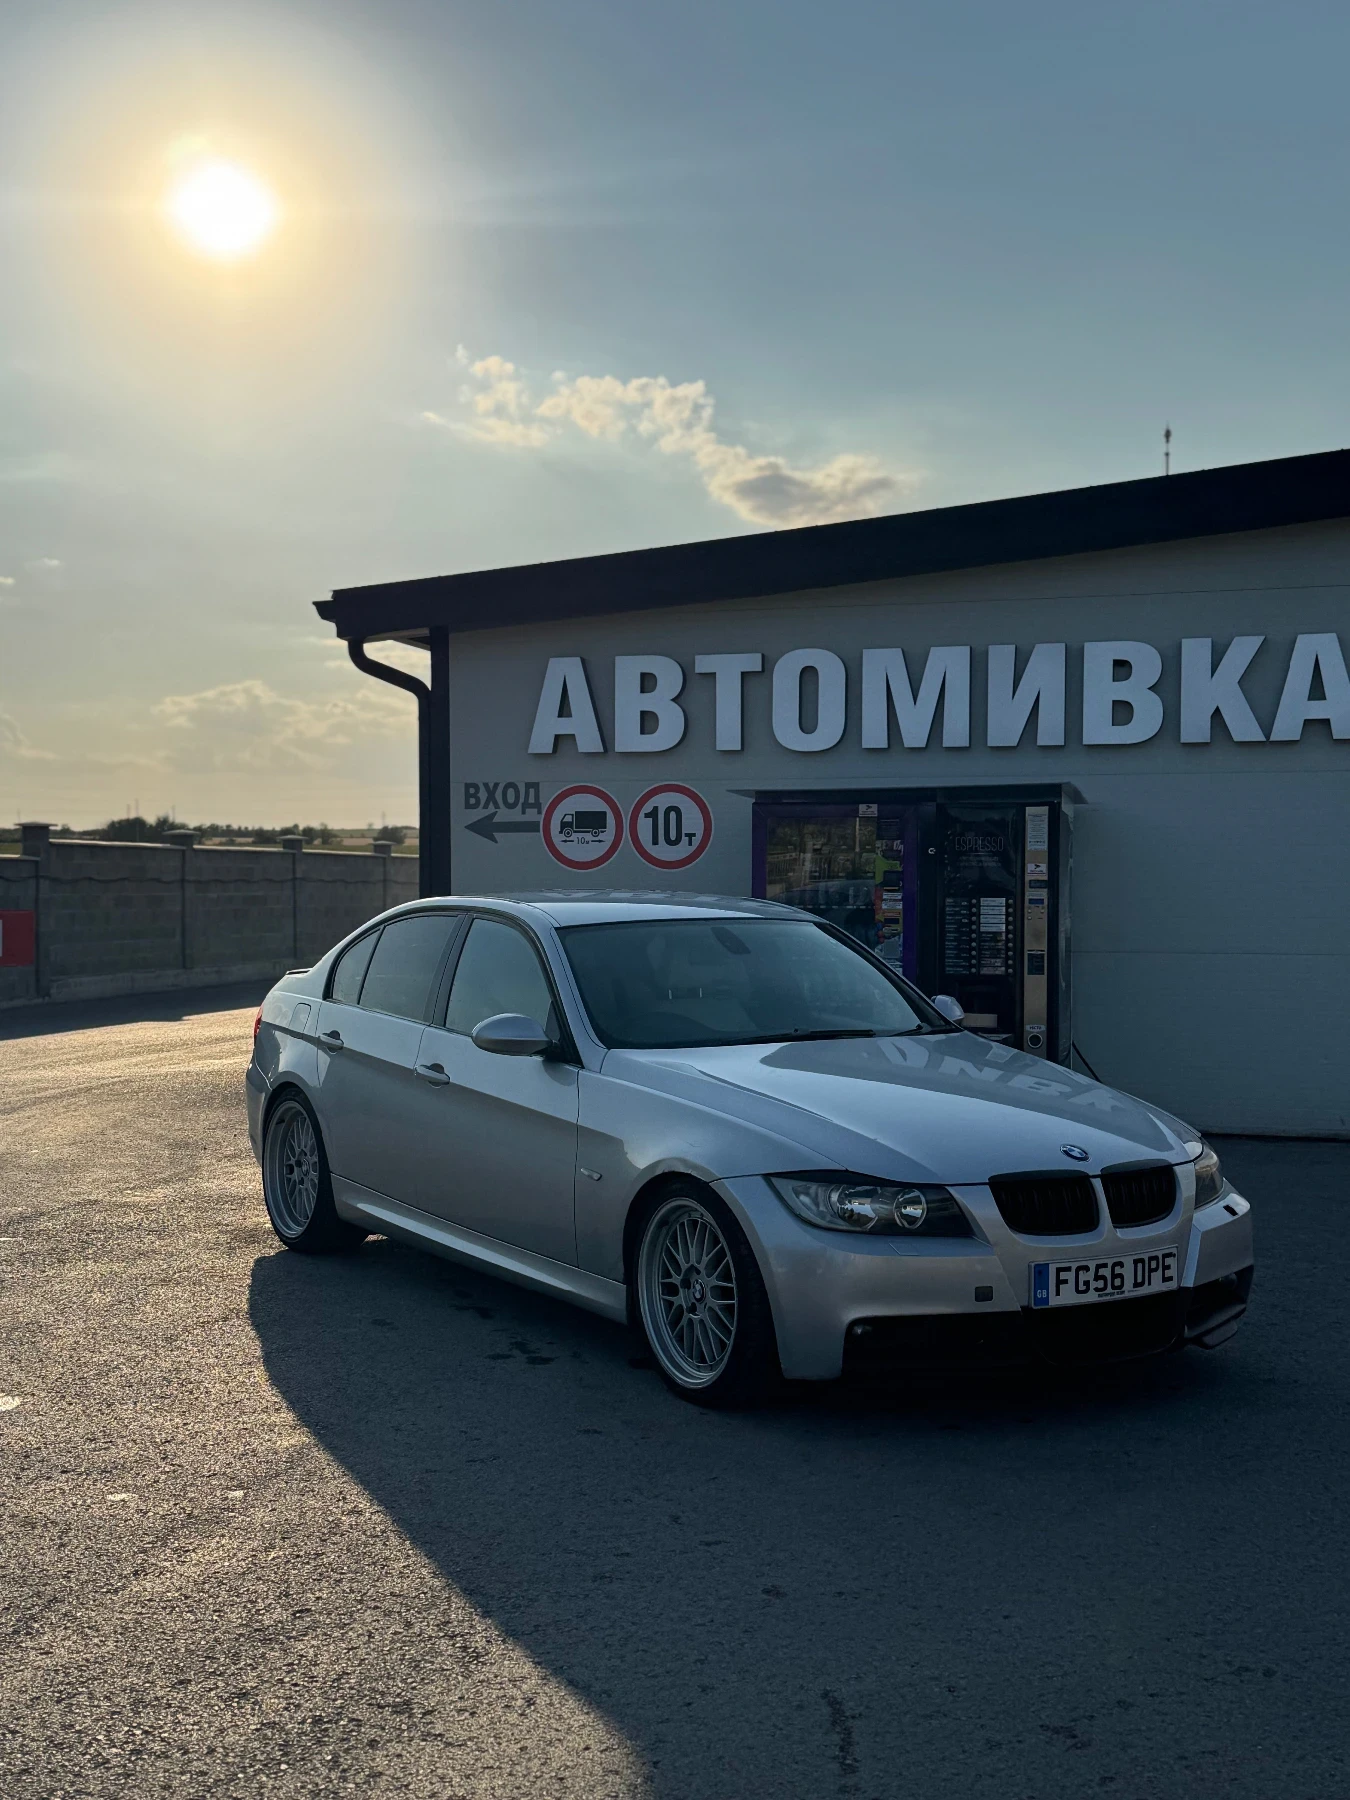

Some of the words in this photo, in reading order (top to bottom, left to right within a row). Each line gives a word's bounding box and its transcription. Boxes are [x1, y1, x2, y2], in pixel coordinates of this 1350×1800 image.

[528, 632, 1350, 754] АВТОМИВКА
[464, 781, 542, 815] ВХОД
[955, 836, 1004, 851] ESPRESSO
[1055, 1260, 1125, 1297] FG56
[1132, 1251, 1175, 1289] DPE
[1036, 1289, 1047, 1298] GB
